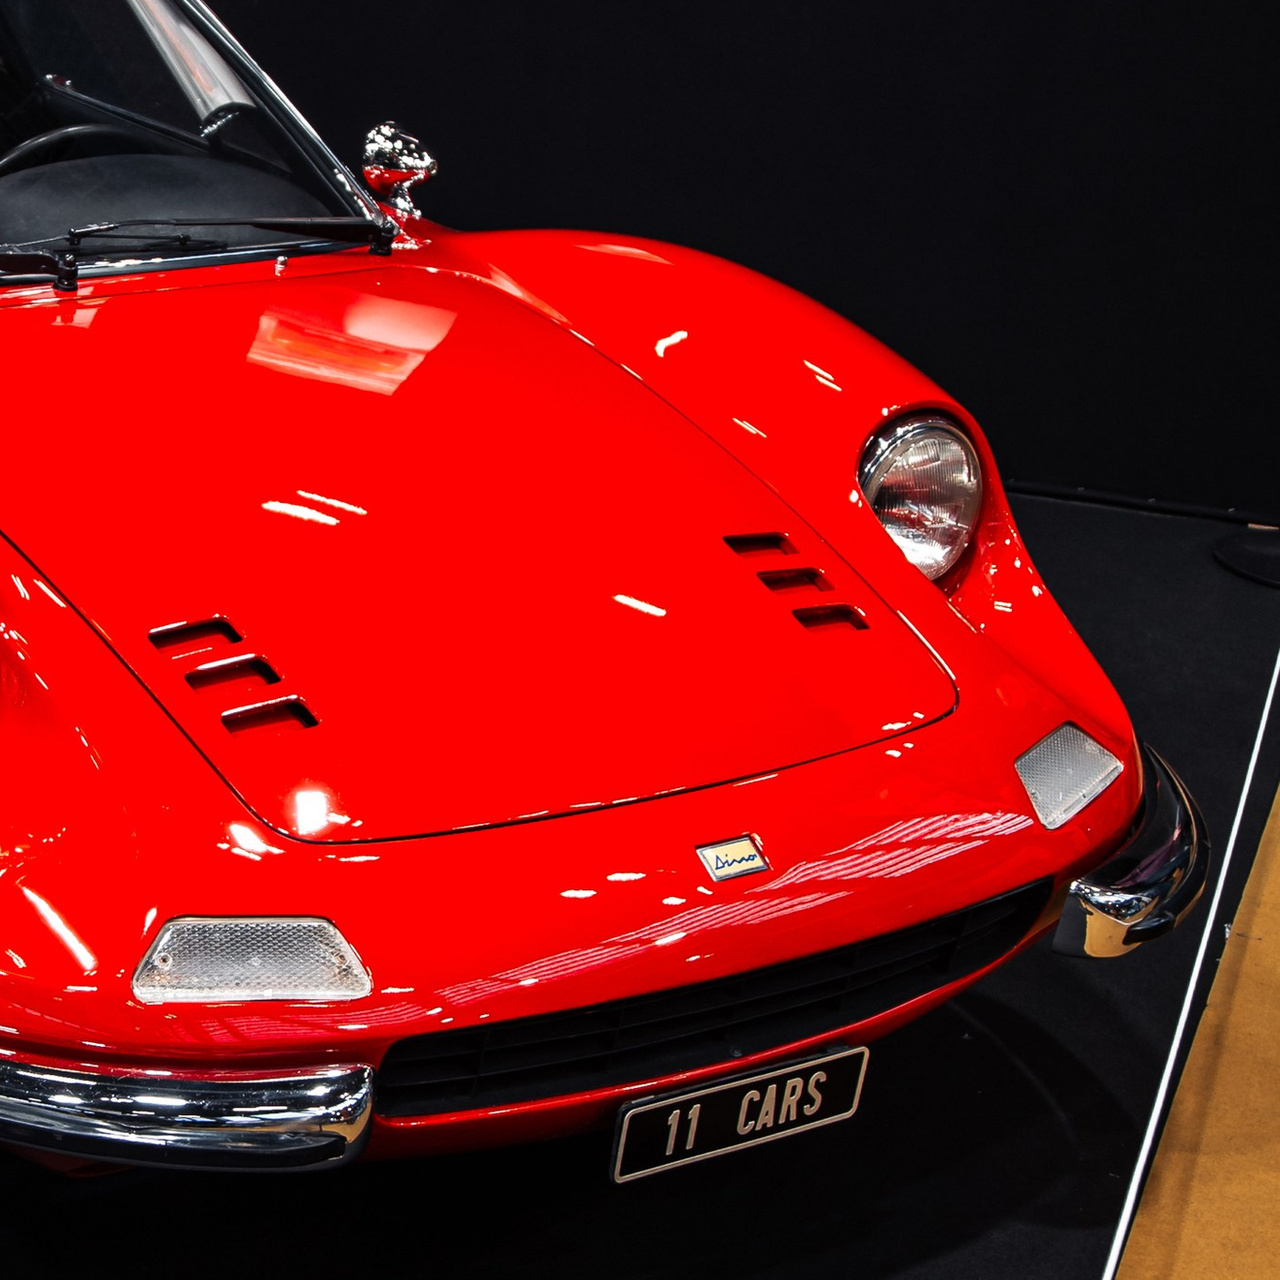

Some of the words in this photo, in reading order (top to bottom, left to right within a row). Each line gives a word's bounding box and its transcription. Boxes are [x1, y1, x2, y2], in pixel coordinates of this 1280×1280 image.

[715, 853, 758, 870] Dino
[665, 1103, 702, 1156] 11
[736, 1071, 827, 1136] CARS
